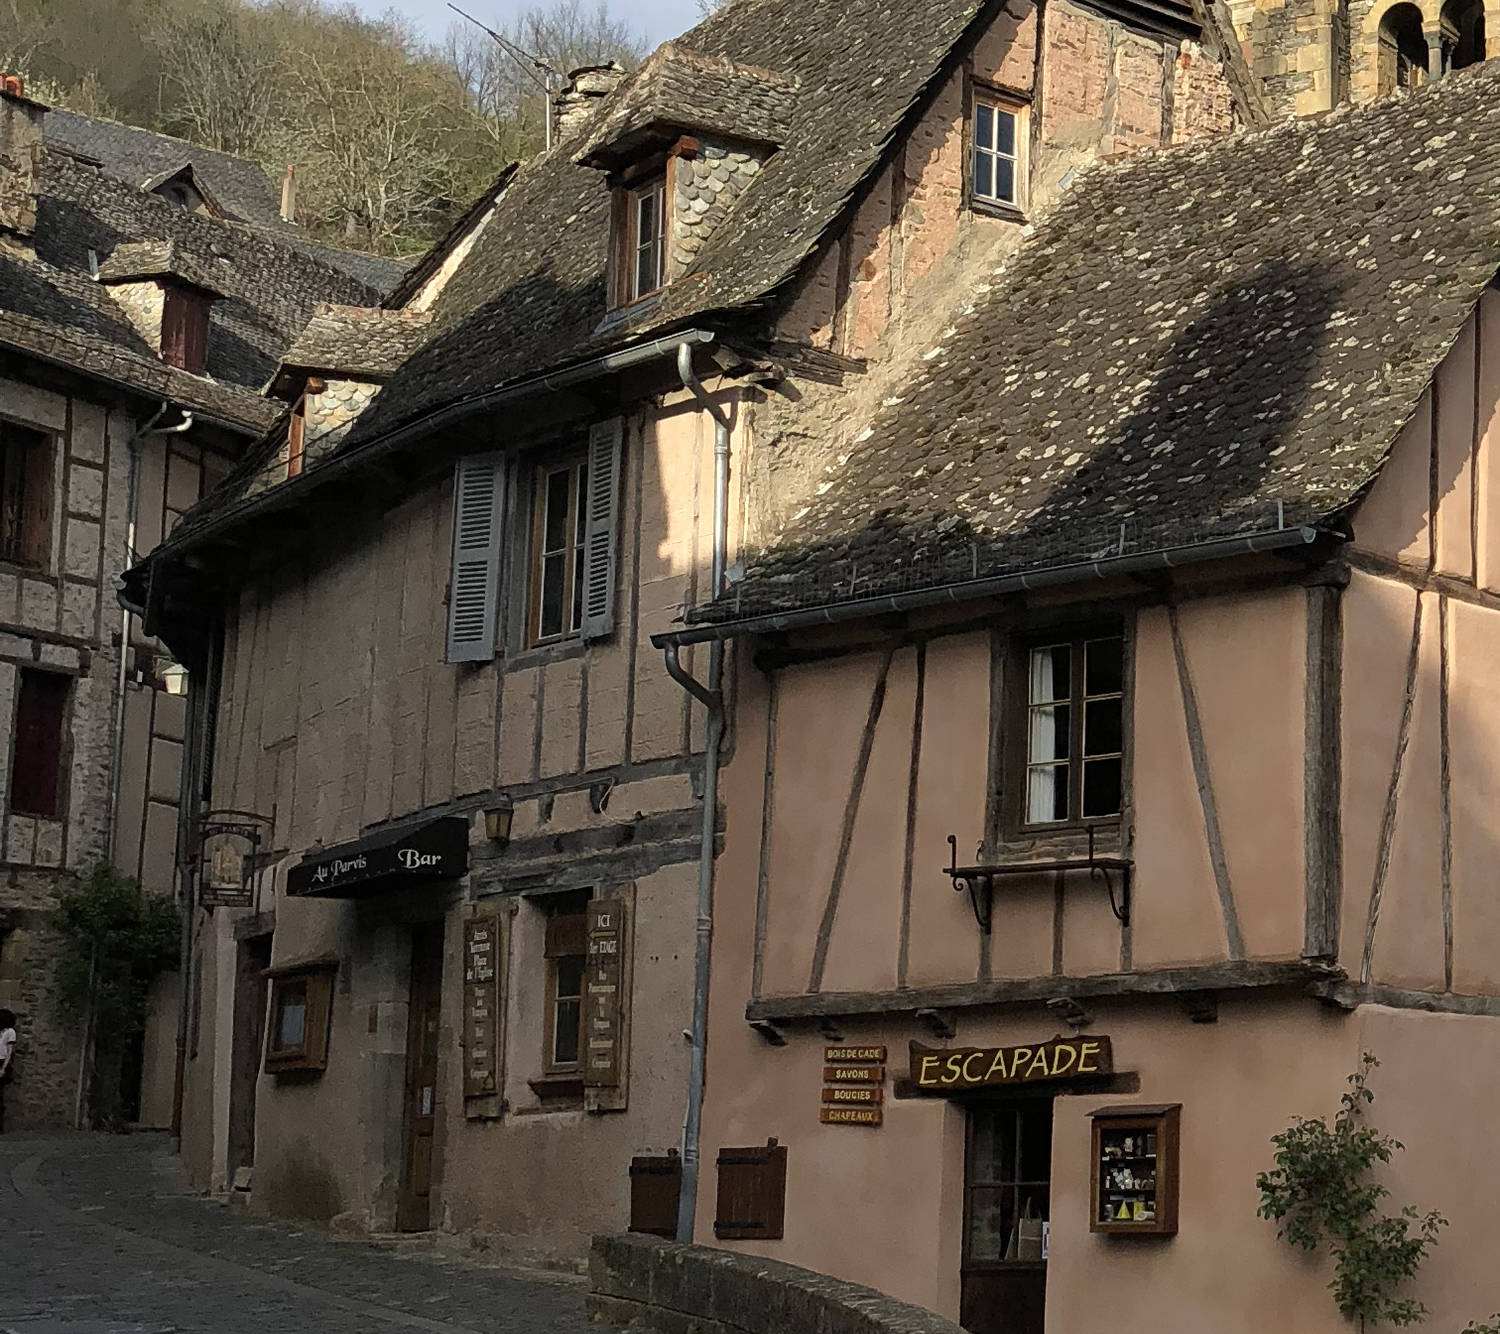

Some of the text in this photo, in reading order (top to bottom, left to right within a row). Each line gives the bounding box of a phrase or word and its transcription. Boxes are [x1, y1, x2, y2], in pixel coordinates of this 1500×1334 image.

[397, 849, 442, 869] Bar
[312, 854, 367, 882] Au Parvis
[598, 914, 611, 928] ICI
[827, 1048, 880, 1059] BOIS DE CADE
[919, 1042, 1101, 1085] ESCAPADE
[835, 1069, 869, 1079] SAVONS
[833, 1090, 871, 1100] BOUGIES
[828, 1110, 874, 1121] CHAPEAUX
